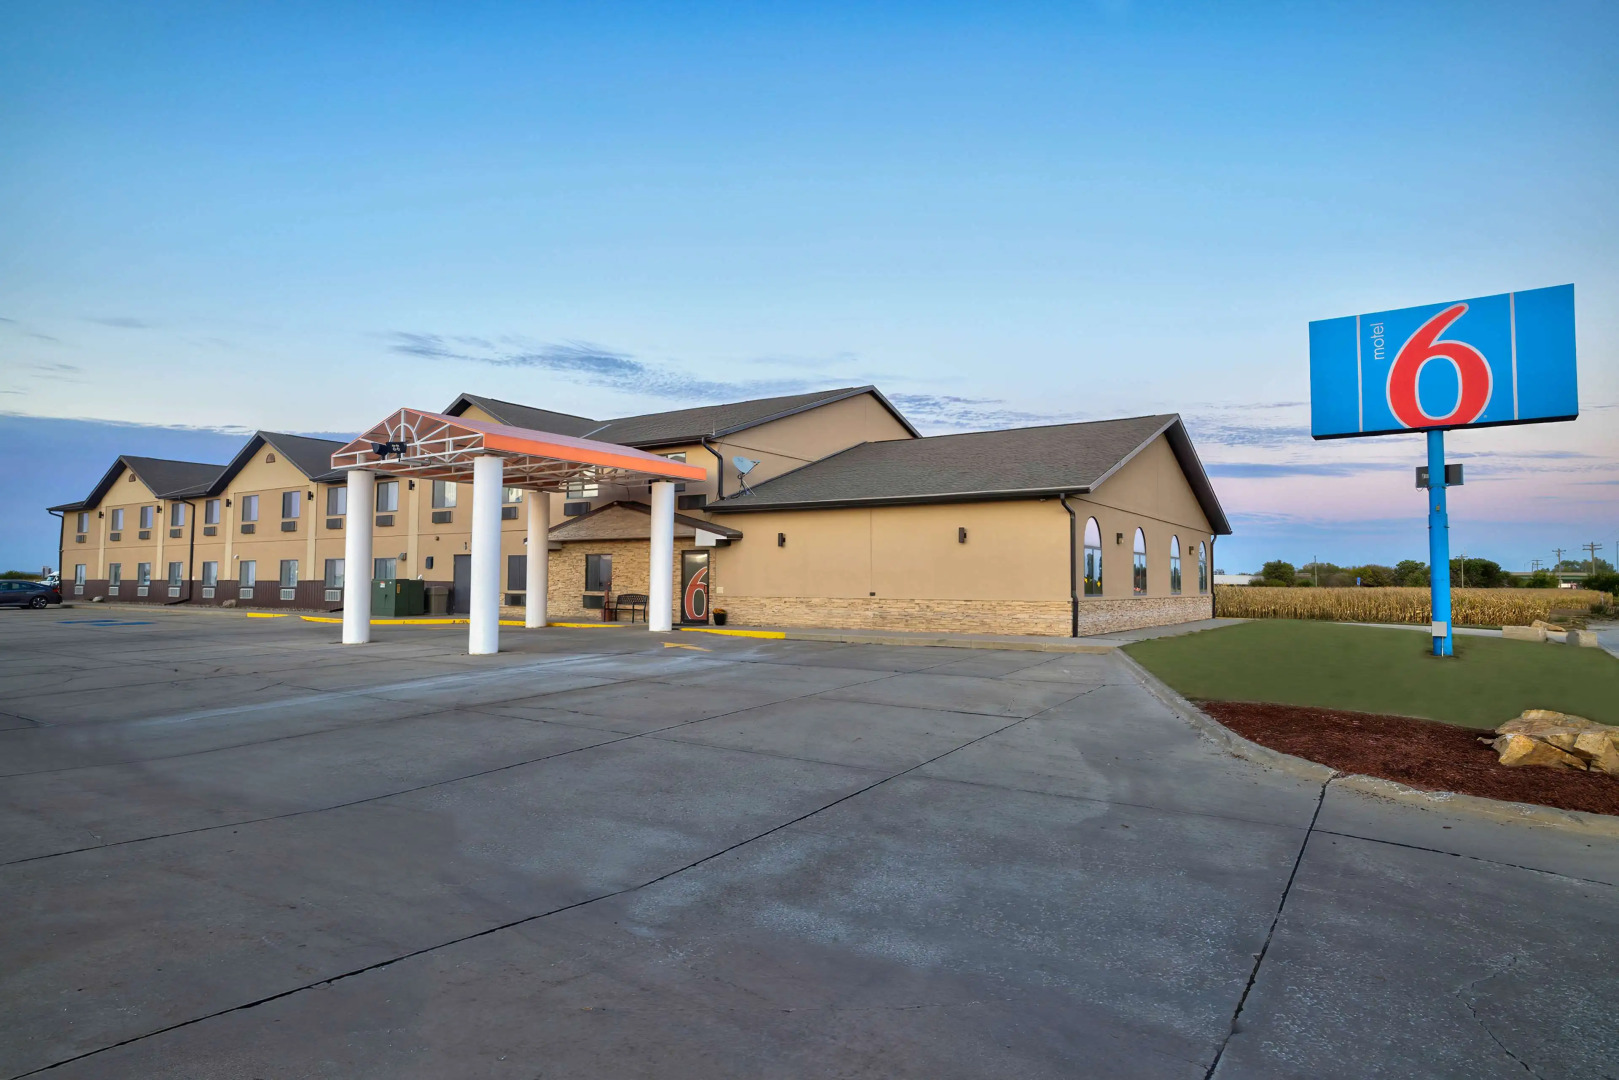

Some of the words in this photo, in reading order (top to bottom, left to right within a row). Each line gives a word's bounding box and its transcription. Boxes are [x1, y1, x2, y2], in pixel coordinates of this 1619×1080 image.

[1370, 322, 1385, 360] motel
[1386, 302, 1493, 428] 6
[685, 566, 708, 620] 6
